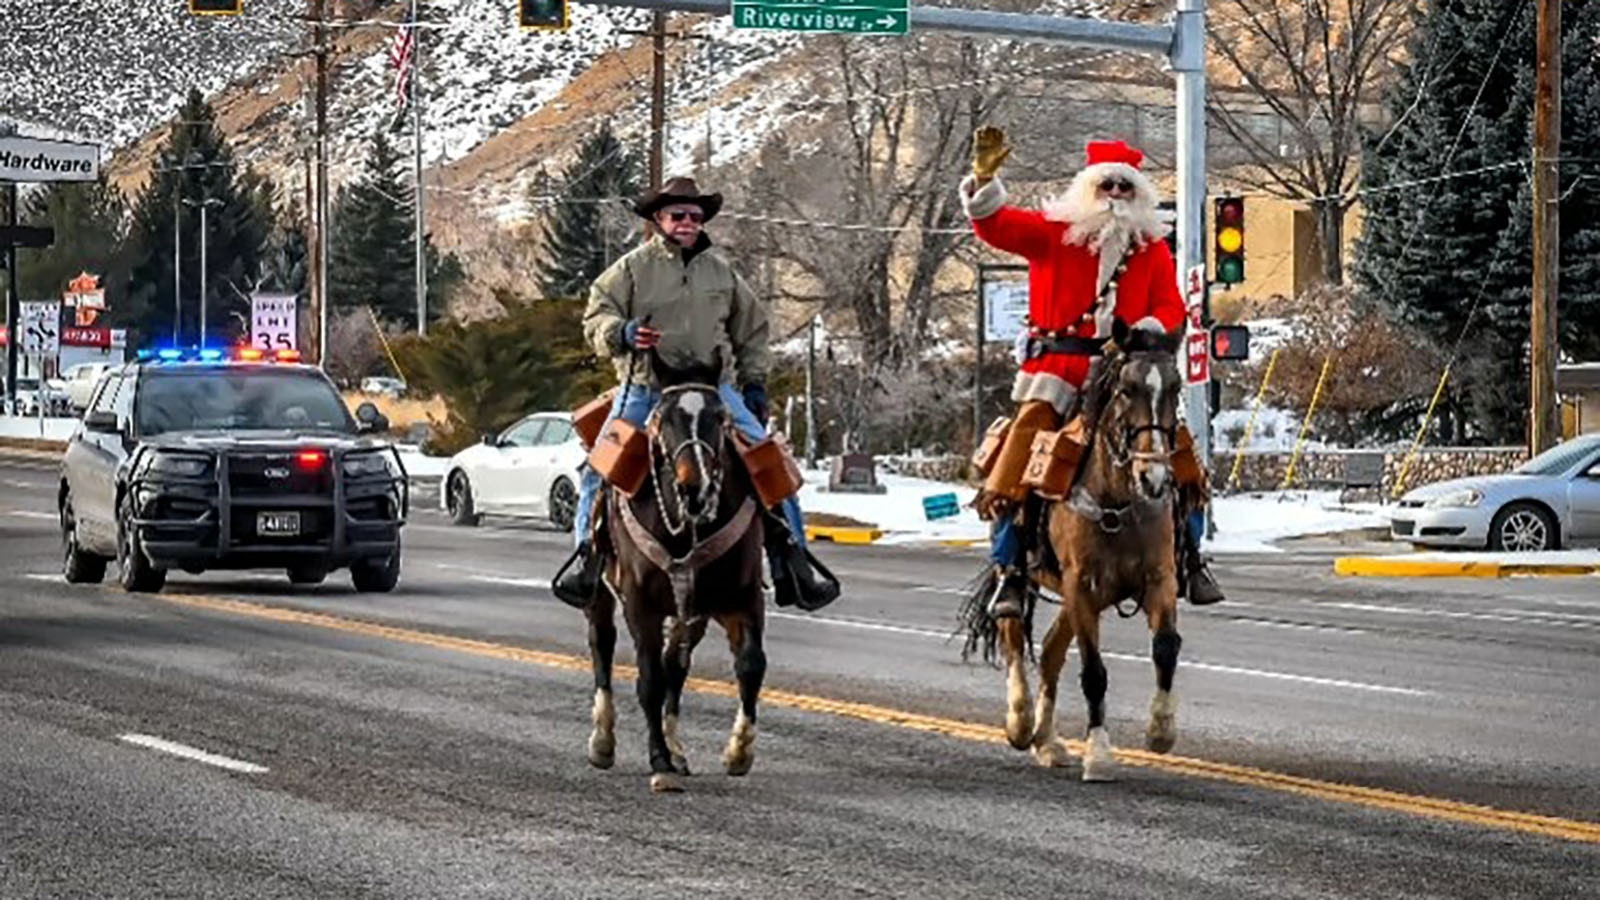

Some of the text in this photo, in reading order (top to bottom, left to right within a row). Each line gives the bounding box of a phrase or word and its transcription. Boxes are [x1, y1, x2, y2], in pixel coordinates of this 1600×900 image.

[742, 7, 856, 29] Riverview
[0, 150, 92, 172] Hardware
[257, 332, 292, 350] 35
